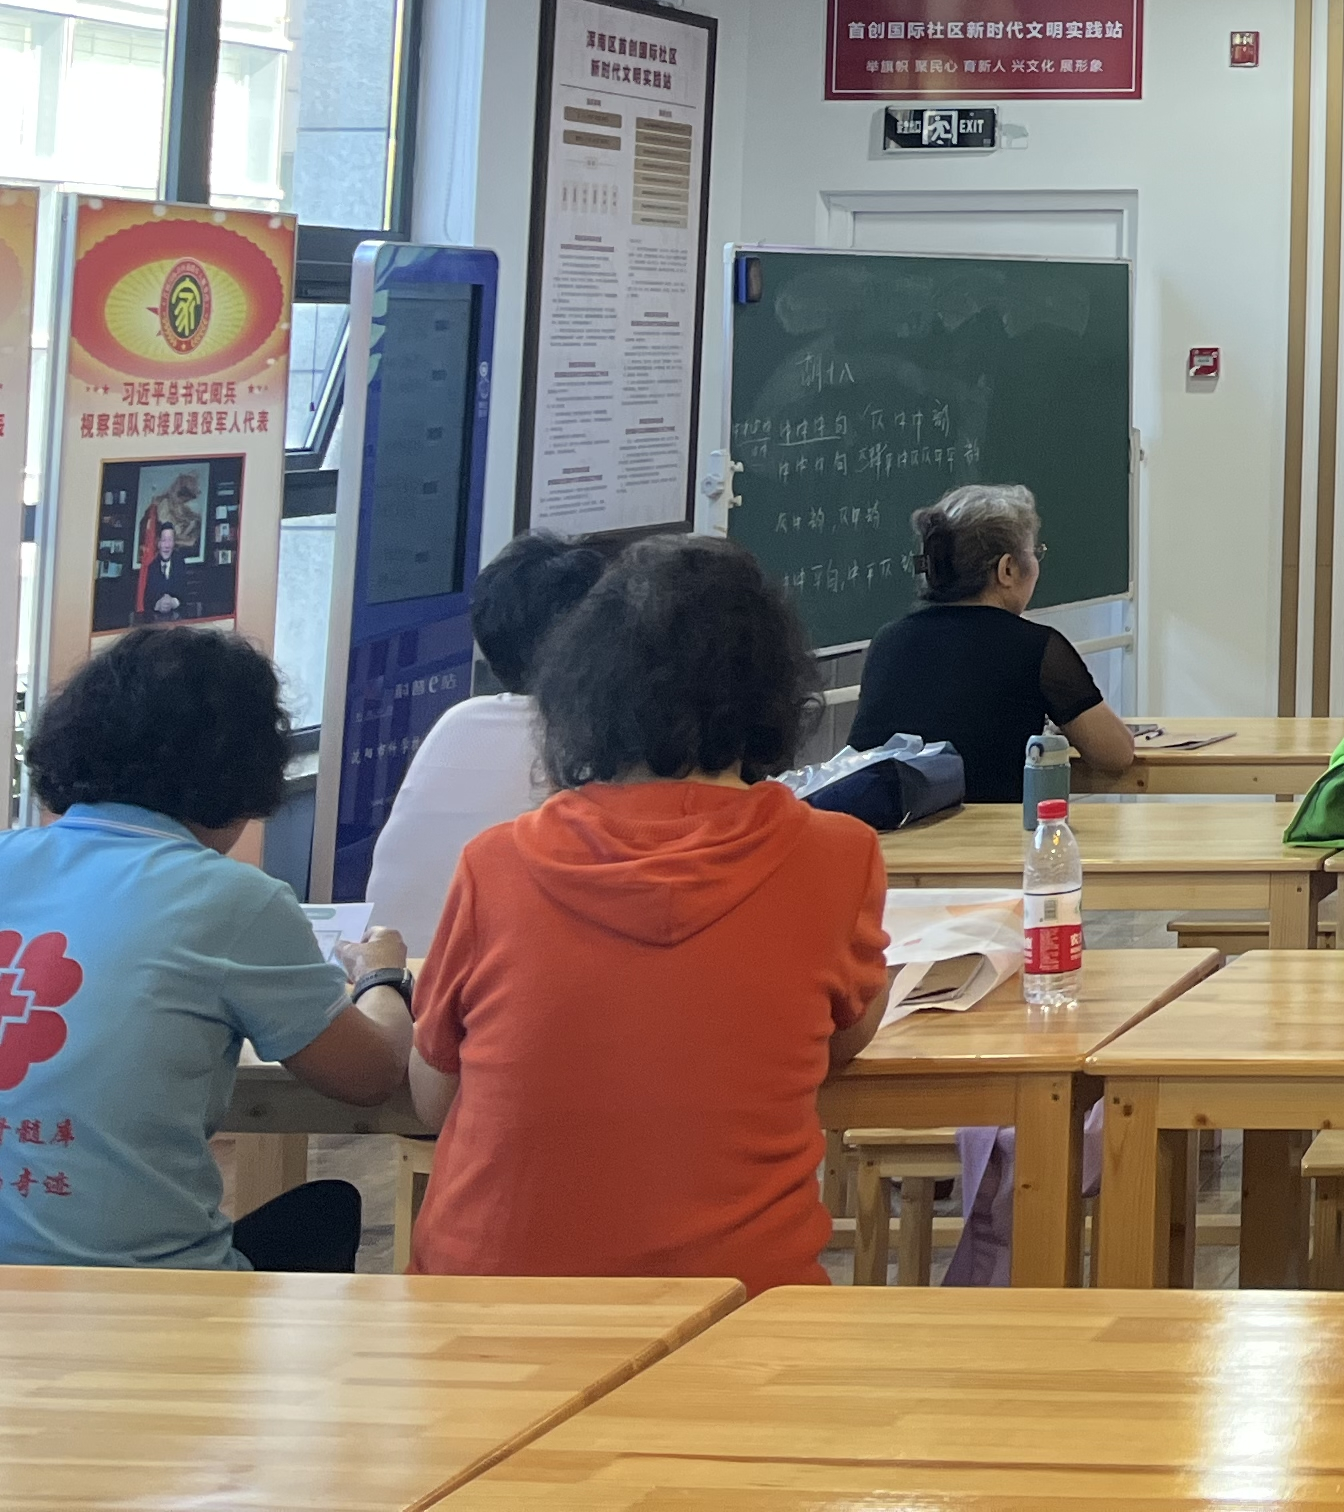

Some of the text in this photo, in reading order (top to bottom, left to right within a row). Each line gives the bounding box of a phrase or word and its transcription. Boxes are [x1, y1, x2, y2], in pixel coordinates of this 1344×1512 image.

[847, 20, 1124, 40] 首创国际社区新时代文明实践站
[914, 59, 958, 73] 聚民心
[1011, 59, 1055, 73] 兴文化
[1060, 58, 1104, 73] 展形象
[959, 119, 985, 134] EXIT
[121, 381, 237, 406] 习近平总书记阅兵
[80, 411, 269, 438] 视察部队和接见退役军人代表
[0, 1167, 73, 1198] 奇迹
